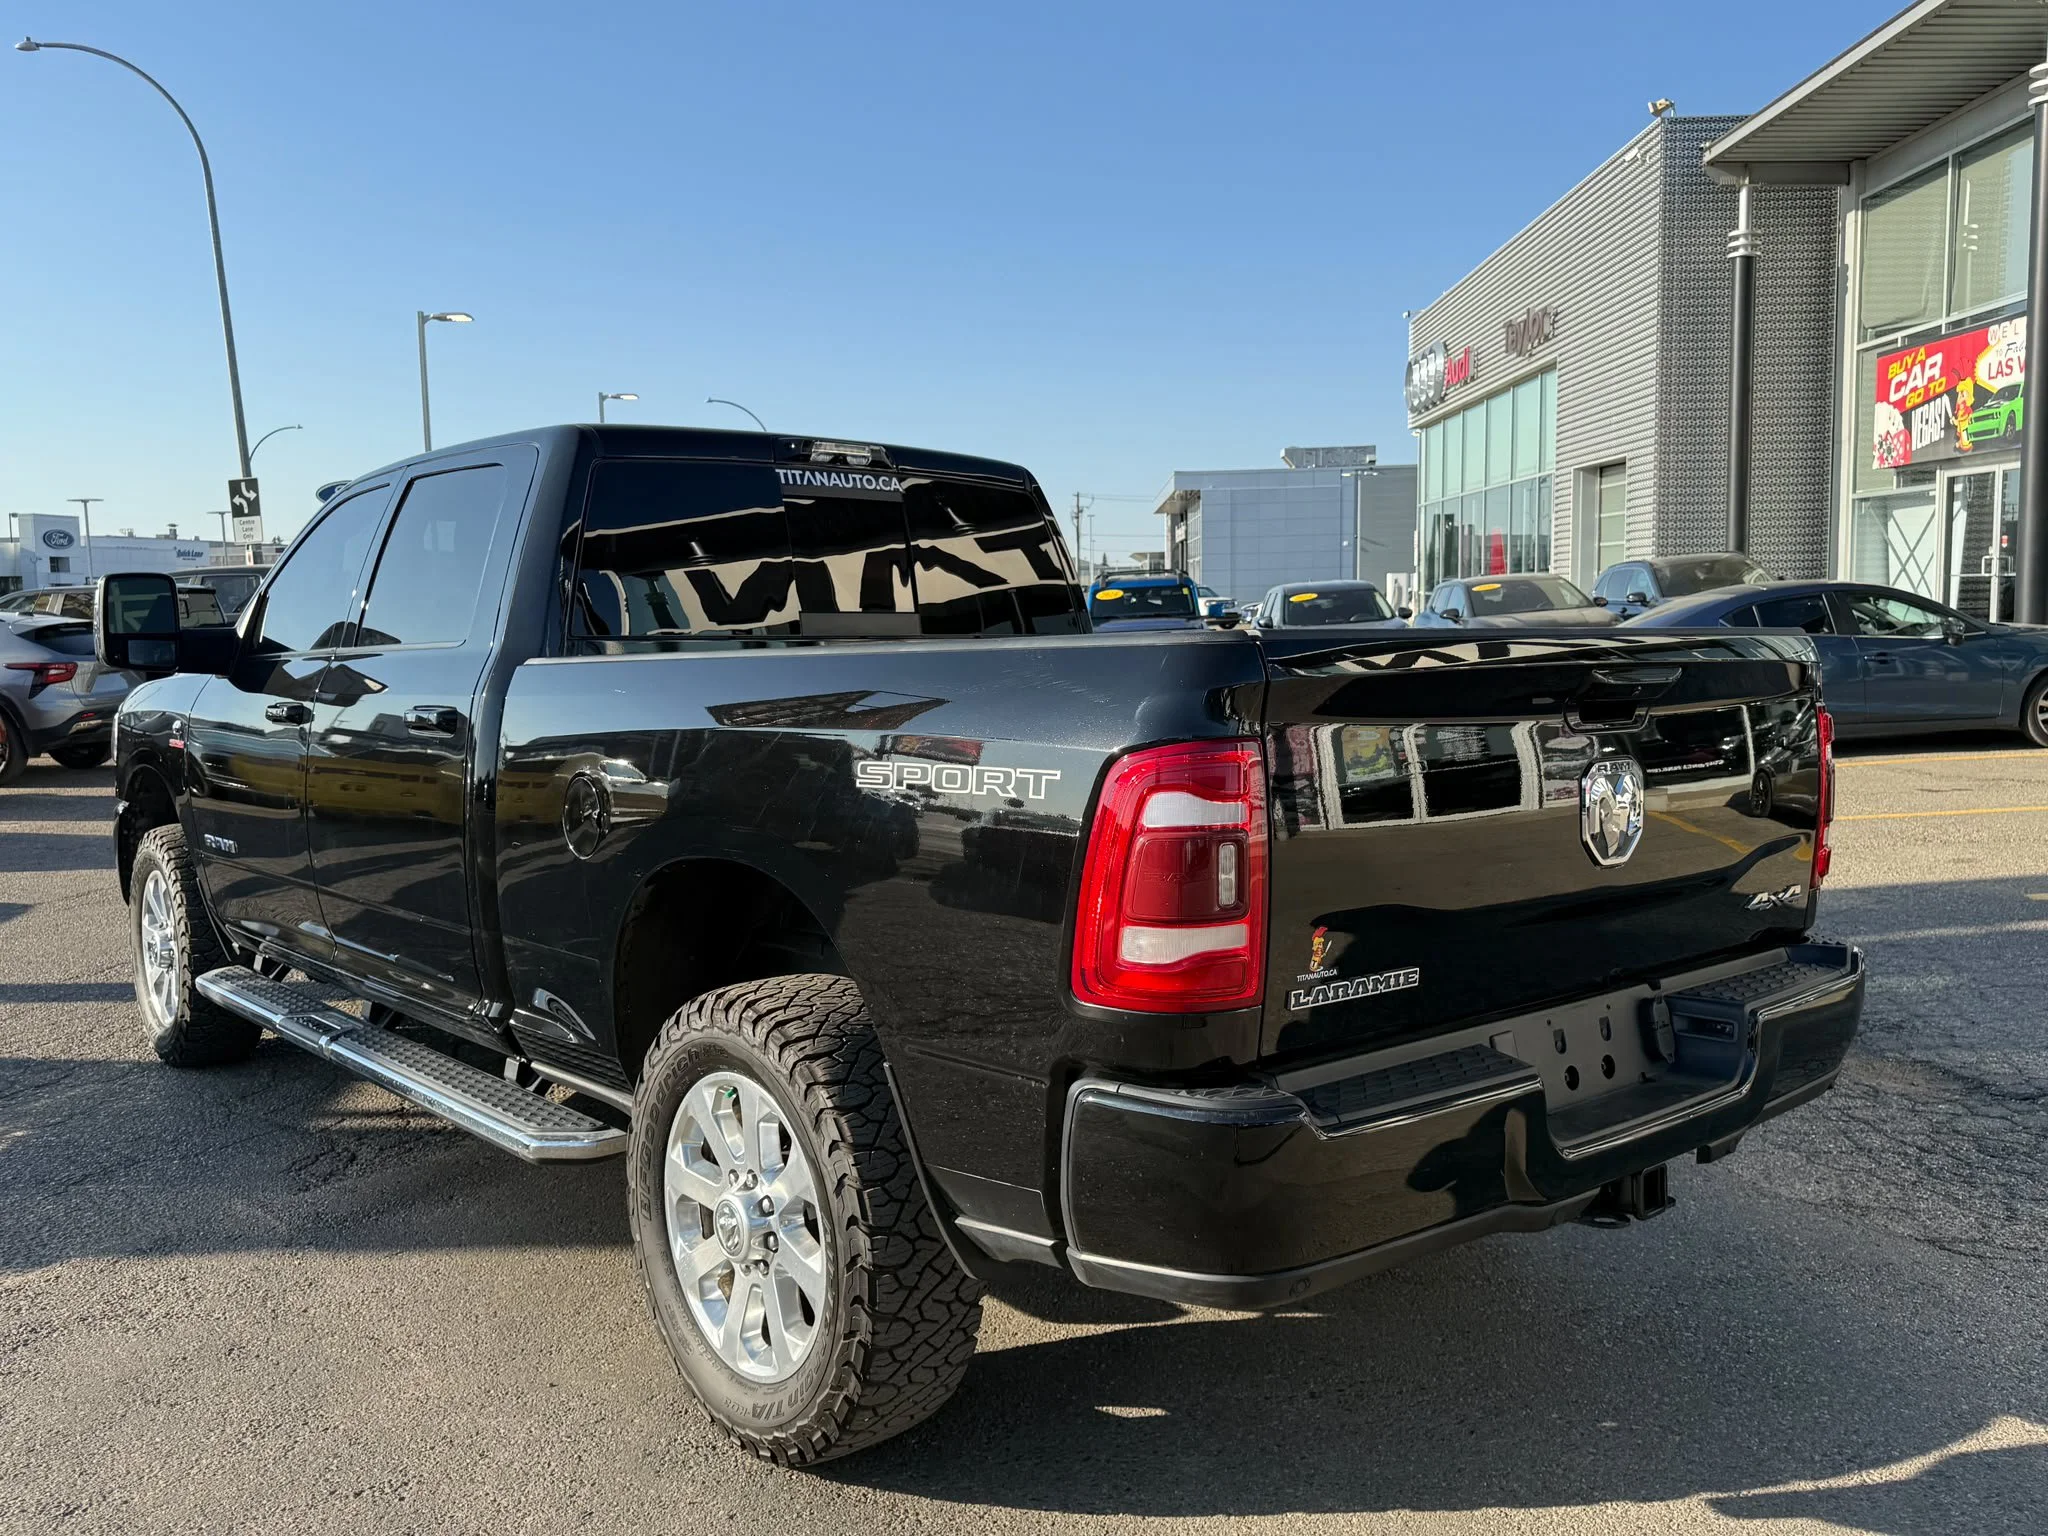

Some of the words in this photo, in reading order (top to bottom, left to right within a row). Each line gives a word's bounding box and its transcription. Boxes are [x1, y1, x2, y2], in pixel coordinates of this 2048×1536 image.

[1445, 345, 1470, 388] Audi
[1888, 350, 1916, 380] BUY
[1914, 346, 1927, 365] A
[1888, 352, 1943, 403] CAR
[1987, 357, 2014, 381] LAS
[1905, 389, 1925, 409] GO
[1928, 376, 1947, 397] TO
[1911, 395, 1946, 452] VEGAS!
[775, 468, 904, 493] TITANAUTO.CA
[176, 548, 191, 558] Quick
[191, 549, 204, 558] Lane
[242, 533, 254, 541] Only
[856, 761, 1061, 800] SPORT
[1597, 761, 1632, 773] RAM
[1289, 967, 1420, 1012] LARAMIE
[1296, 968, 1338, 983] TITANAUTO.CA
[639, 1045, 700, 1222] BFGoodrich
